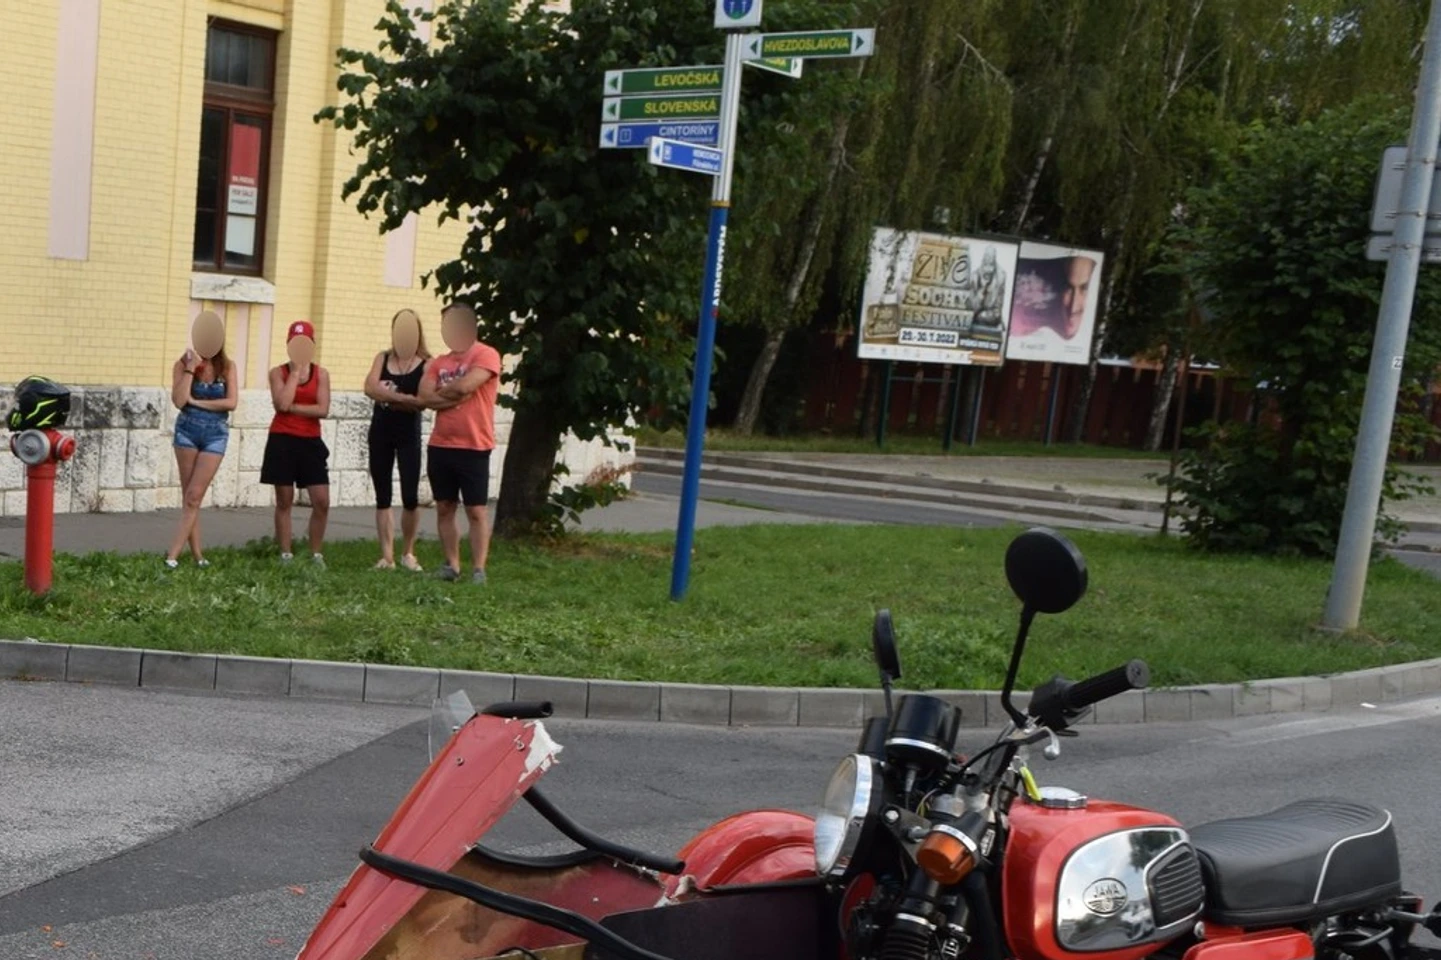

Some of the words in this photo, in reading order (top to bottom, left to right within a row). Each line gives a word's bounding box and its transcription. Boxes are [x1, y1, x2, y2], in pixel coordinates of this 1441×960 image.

[654, 70, 720, 87] LEVOČSKÁ
[643, 98, 717, 114] SLOVENSKÁ
[903, 286, 970, 311] SOCHY
[901, 309, 972, 331] FESTIVAL
